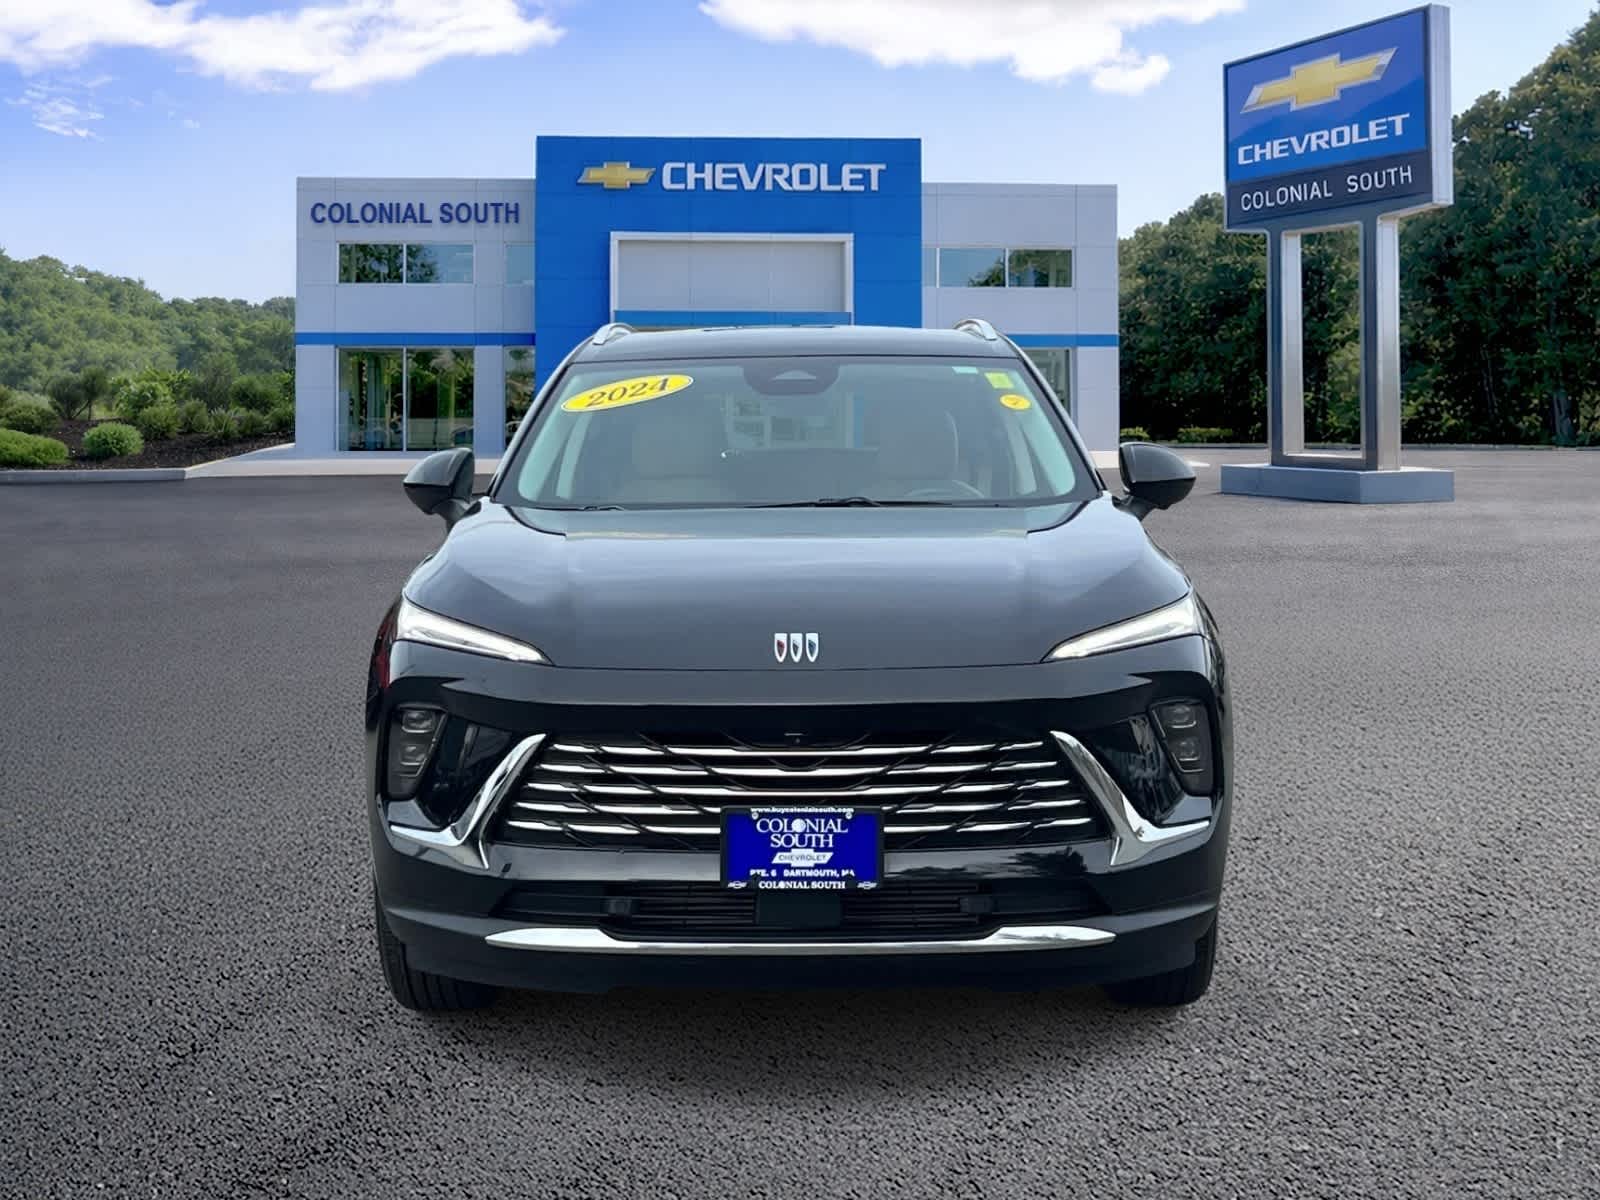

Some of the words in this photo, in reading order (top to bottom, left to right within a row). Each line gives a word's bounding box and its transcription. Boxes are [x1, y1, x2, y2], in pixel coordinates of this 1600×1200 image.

[1238, 113, 1410, 165] CHEVROLET
[661, 162, 886, 193] CHEVROLET
[1240, 181, 1333, 212] COLONIAL
[1346, 165, 1413, 194] SOUTH
[310, 202, 432, 224] COLONIAL
[439, 202, 520, 224] SOUTH
[585, 378, 669, 407] 2024
[756, 818, 848, 833] COLONIAL
[770, 833, 834, 848] SOUTH
[783, 869, 840, 877] DARTMOUTH,
[758, 880, 809, 889] COLONIAL
[811, 881, 846, 889] SOUTH
